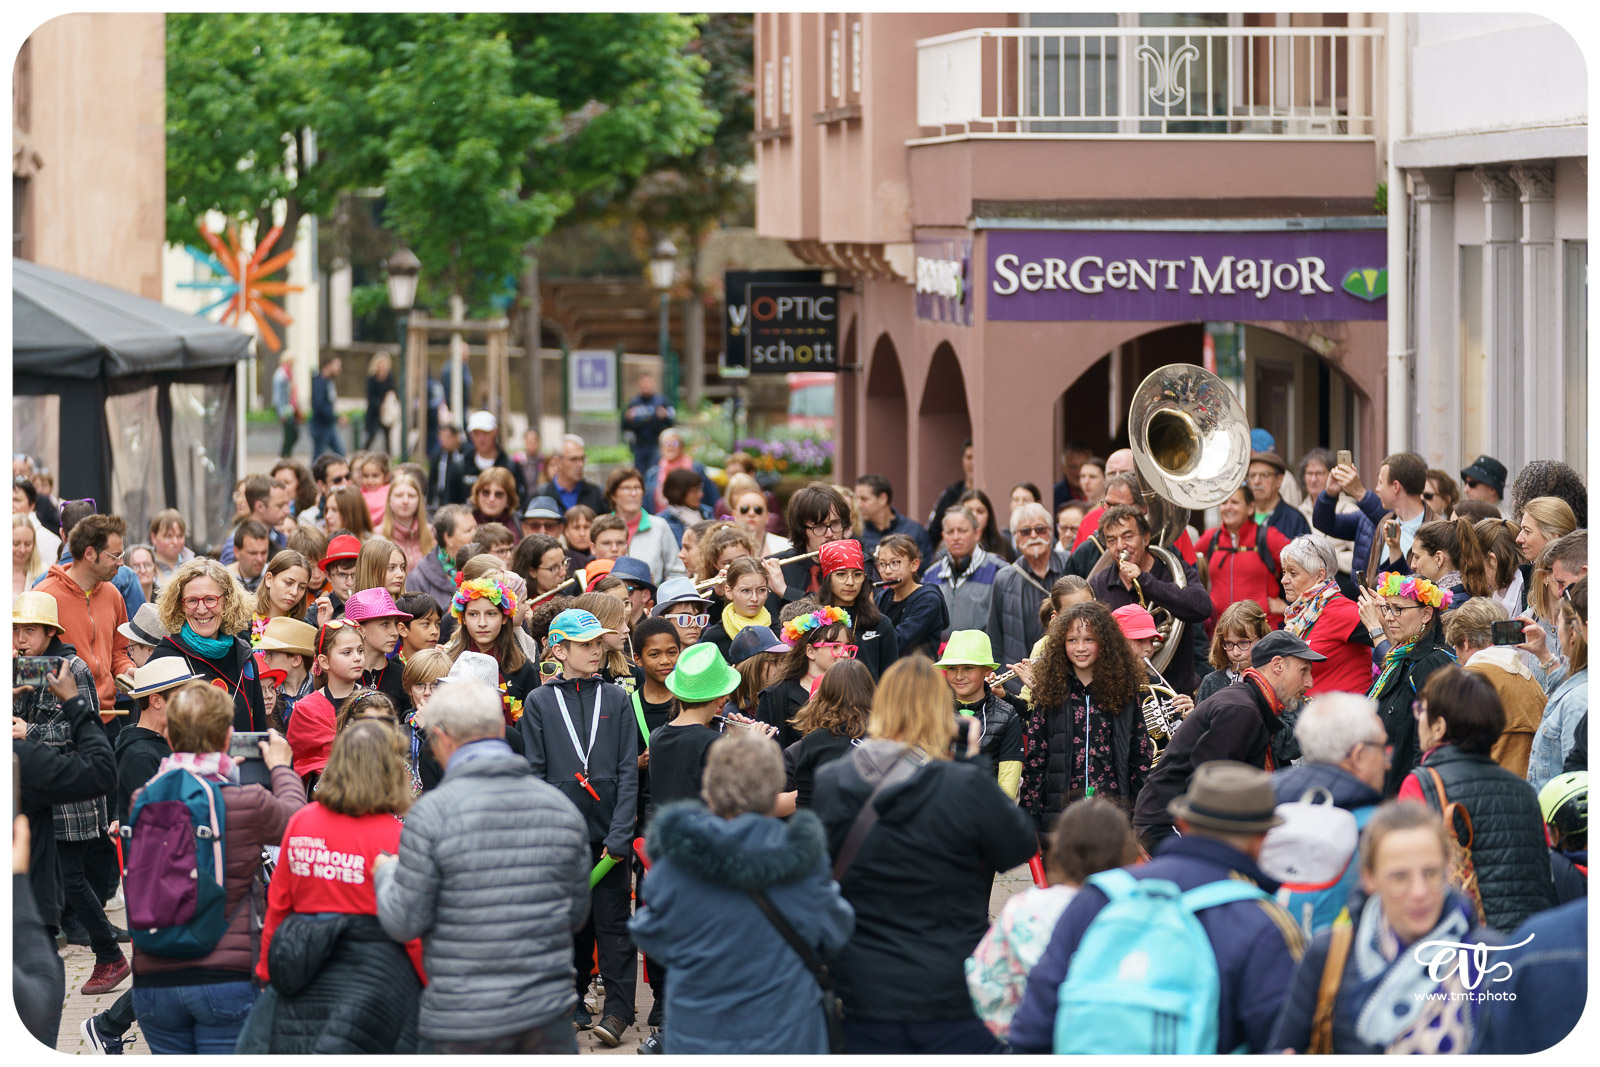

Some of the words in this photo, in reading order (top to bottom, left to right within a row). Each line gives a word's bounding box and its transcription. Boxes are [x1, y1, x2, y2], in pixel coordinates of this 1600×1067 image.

[752, 296, 835, 321] OPTIC
[752, 339, 834, 363] schott
[313, 863, 365, 885] NOTES
